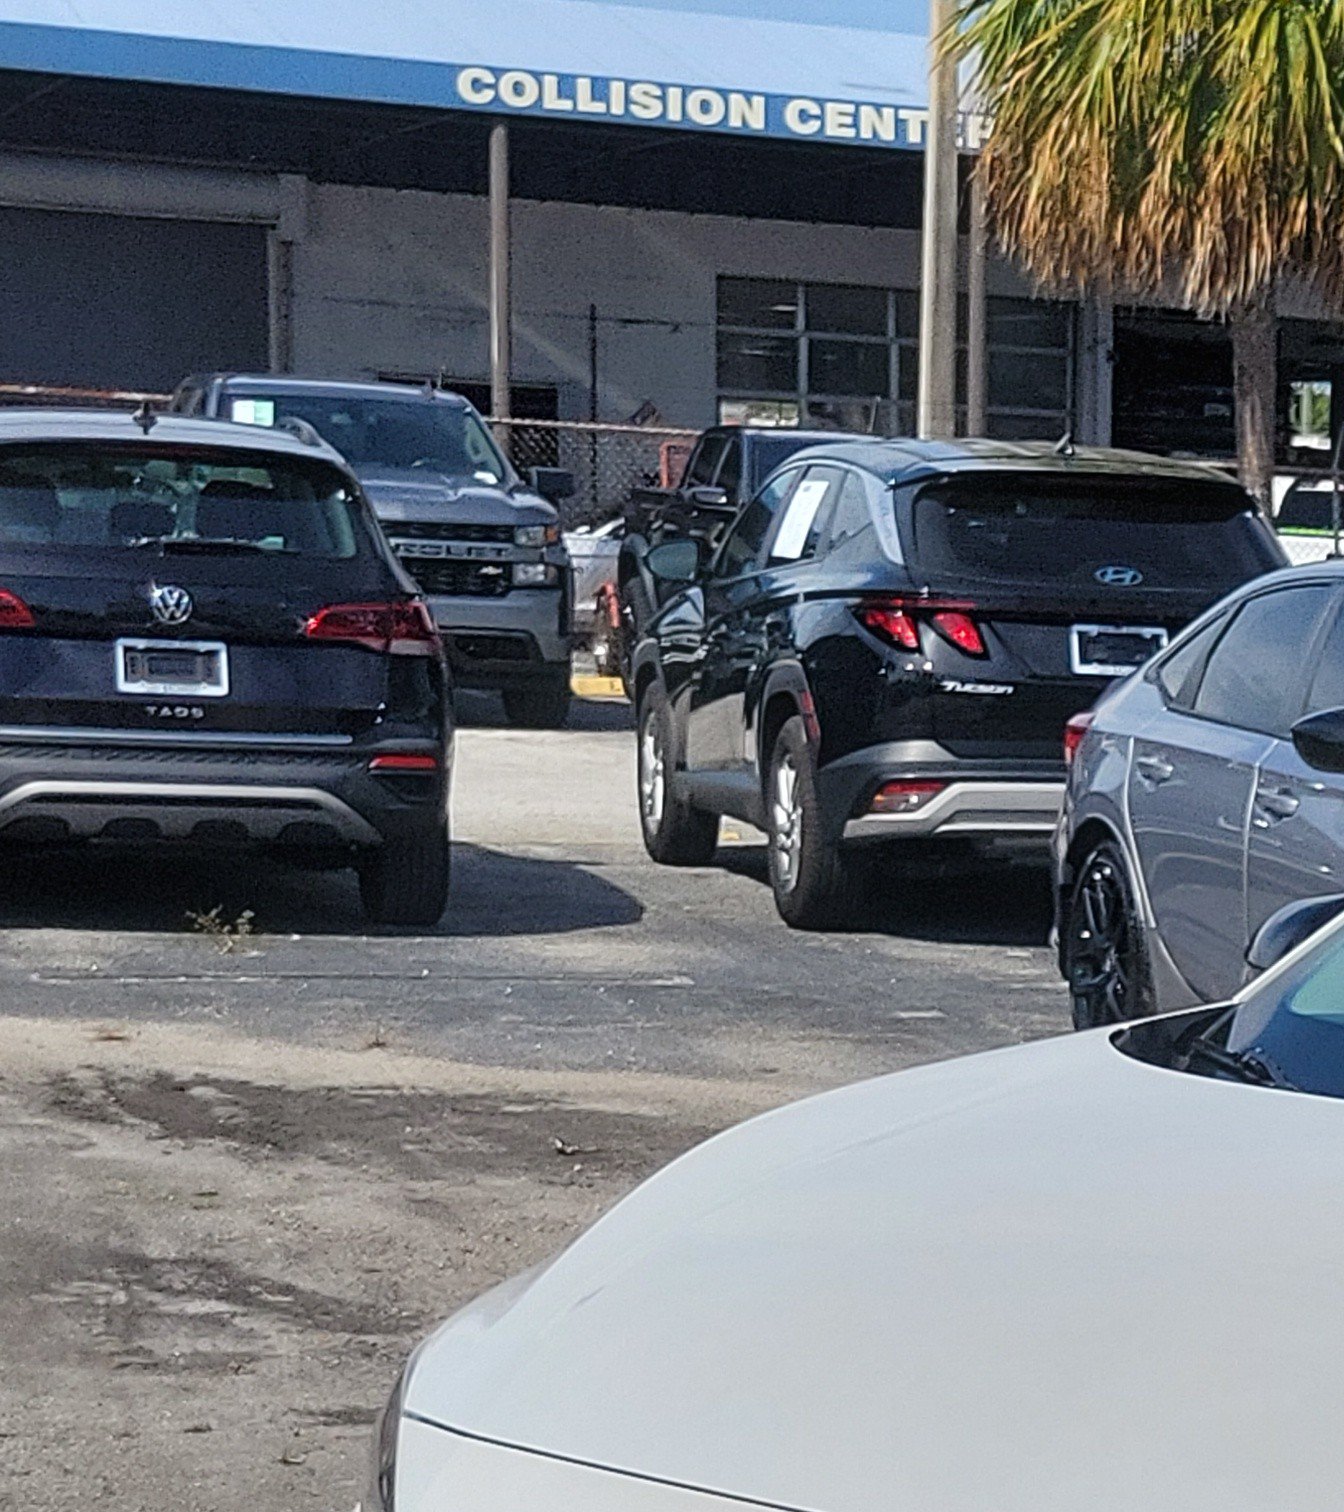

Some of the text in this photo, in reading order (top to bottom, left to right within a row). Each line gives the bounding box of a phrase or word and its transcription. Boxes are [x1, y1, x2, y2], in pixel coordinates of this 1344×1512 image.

[457, 67, 997, 149] COLLISION CENTR
[145, 705, 204, 719] TAOS
